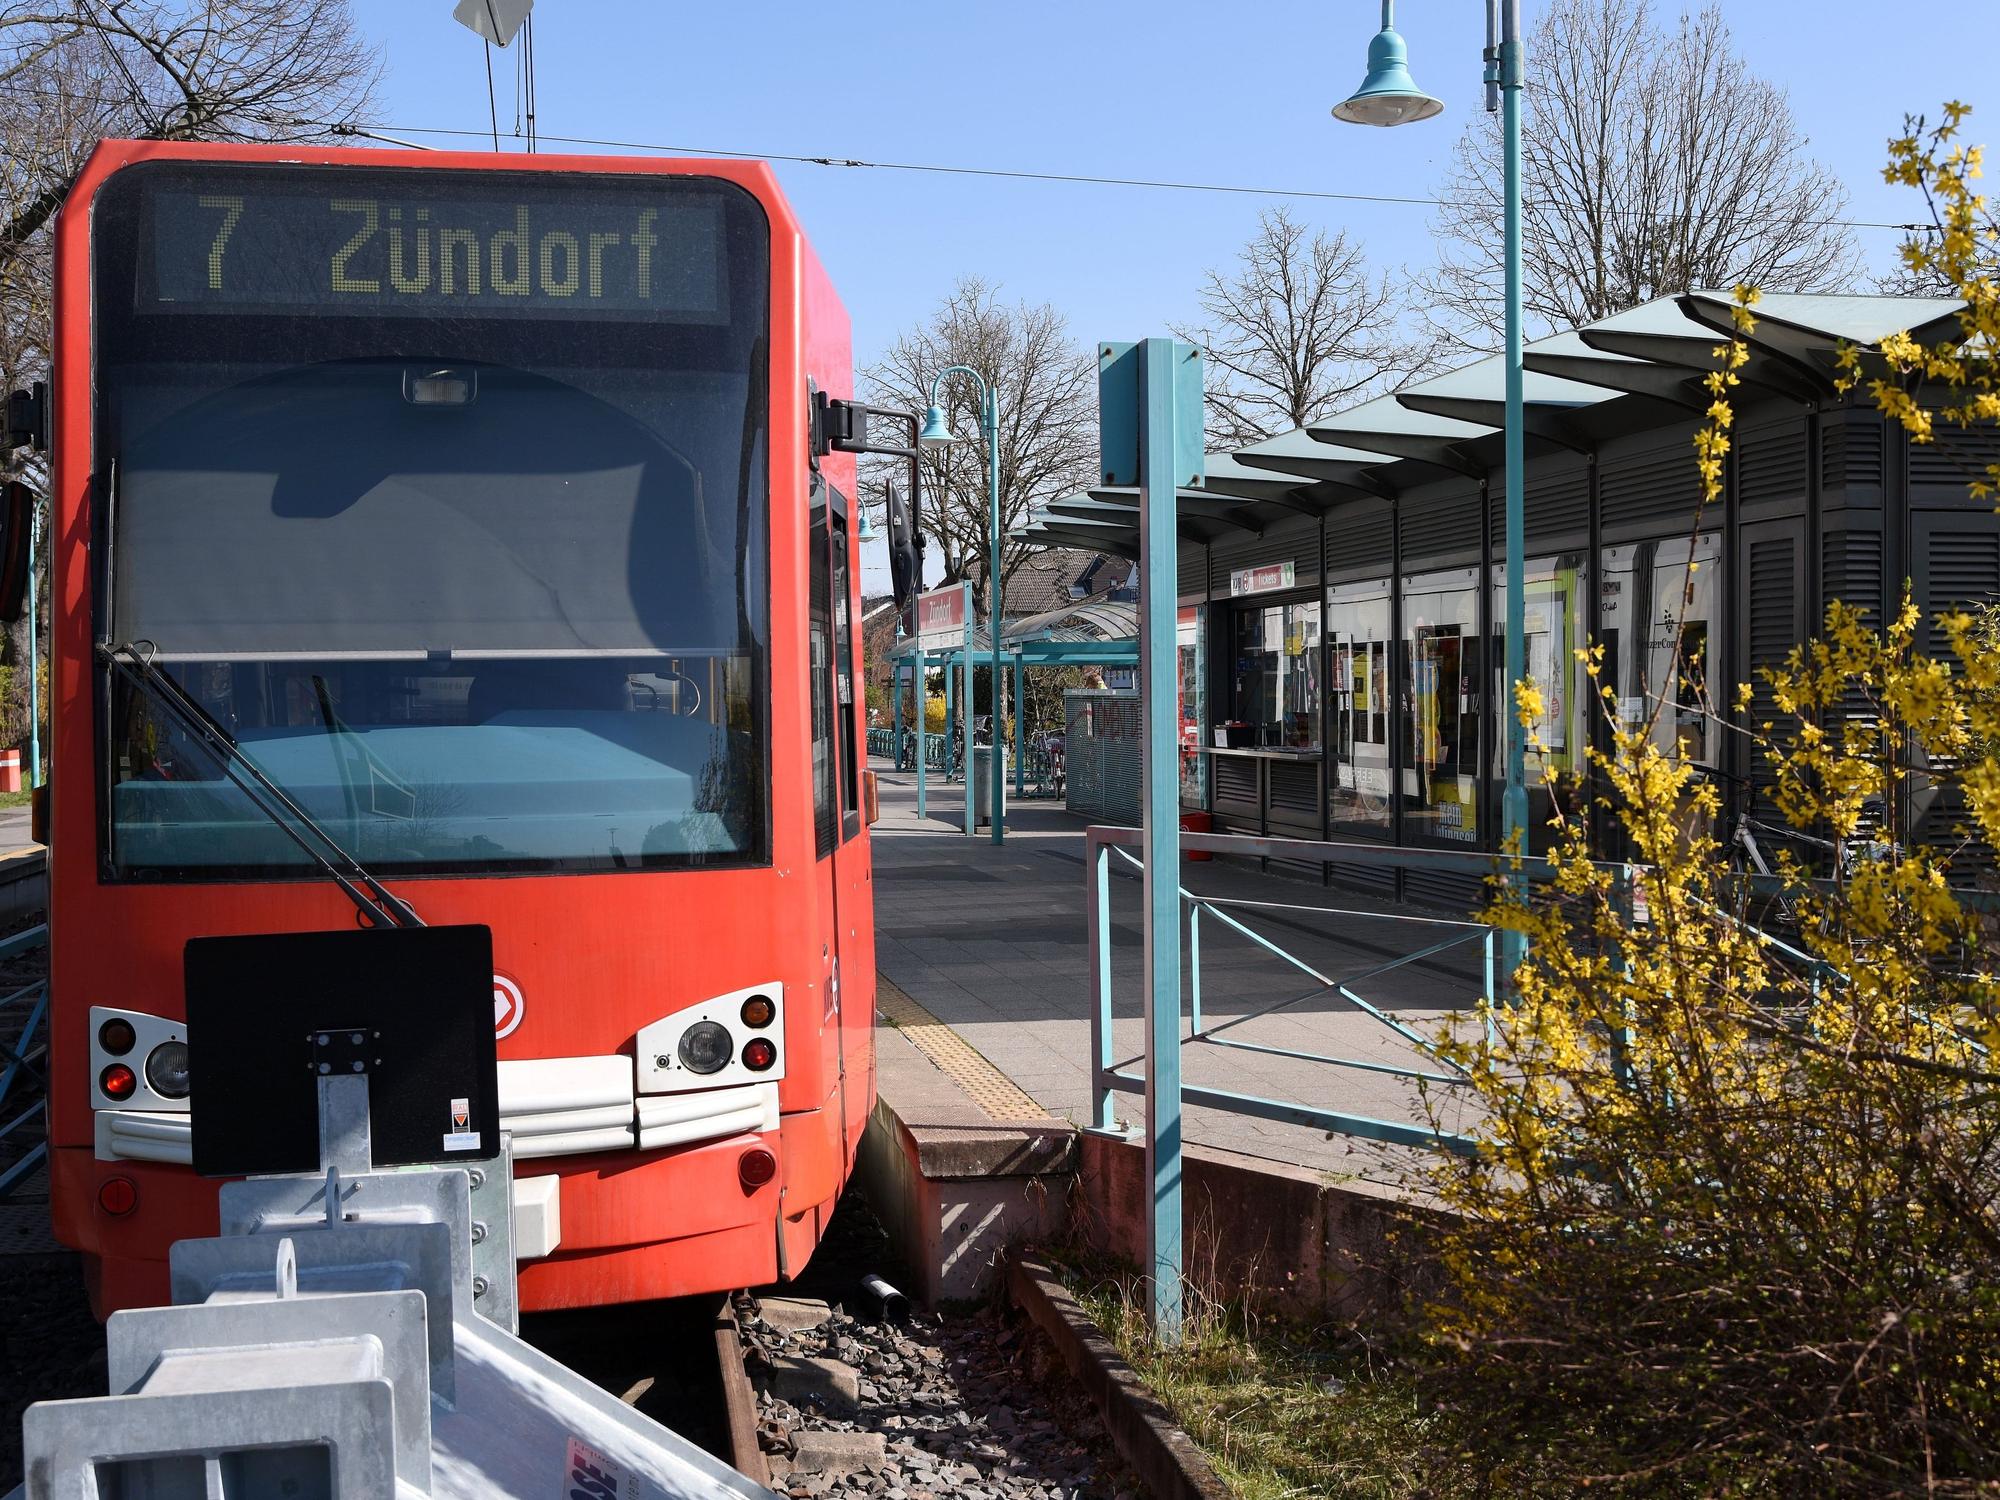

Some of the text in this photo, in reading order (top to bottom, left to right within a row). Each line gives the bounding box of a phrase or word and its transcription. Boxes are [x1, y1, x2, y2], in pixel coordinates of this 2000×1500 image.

[199, 196, 658, 299] 7 Zündorf
[1258, 571, 1277, 588] Tickets
